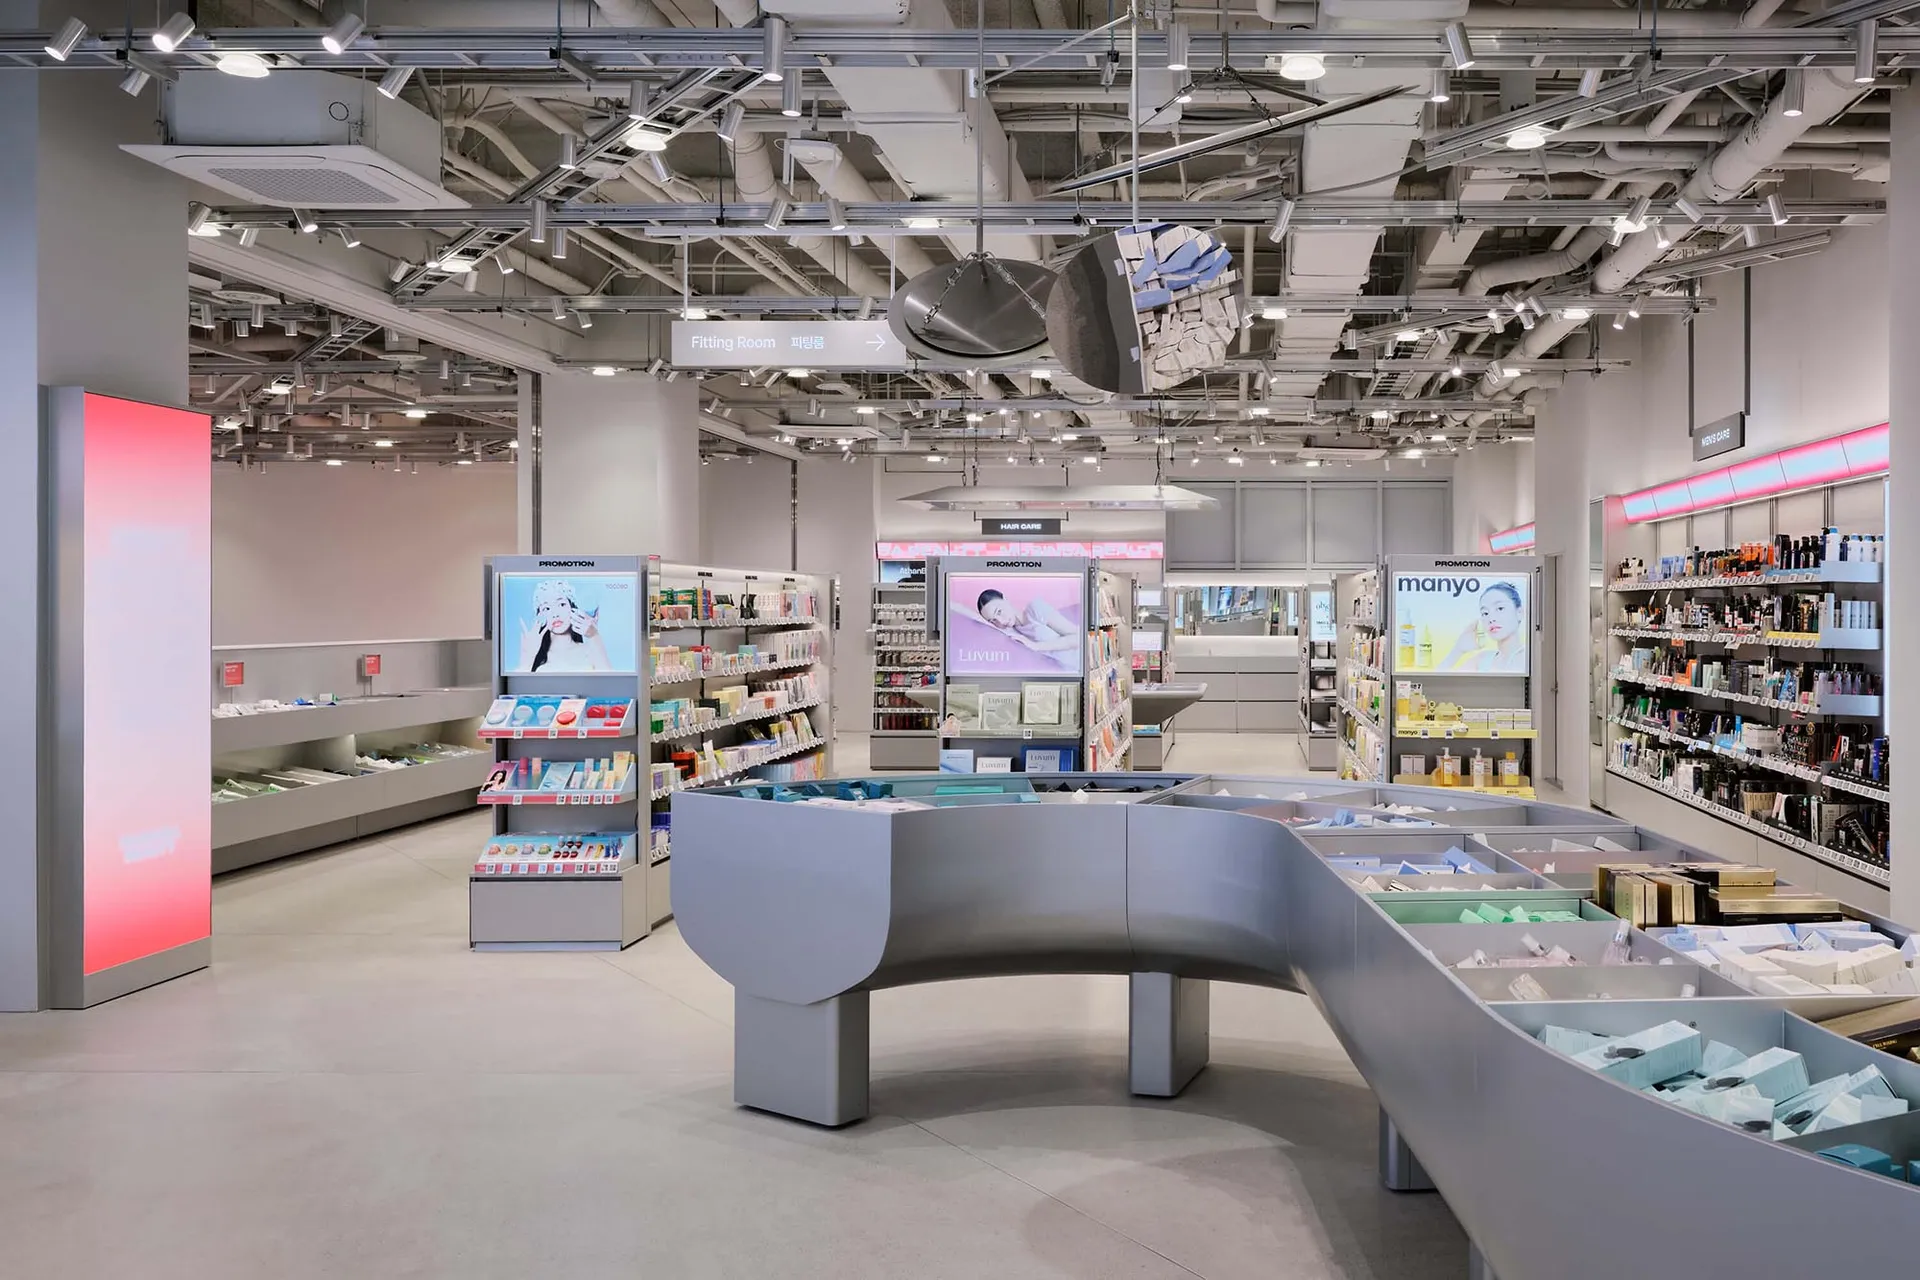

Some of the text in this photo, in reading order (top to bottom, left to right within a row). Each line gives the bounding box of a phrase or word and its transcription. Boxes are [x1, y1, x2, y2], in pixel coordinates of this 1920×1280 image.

[691, 336, 776, 351] Fitting Room
[791, 336, 824, 349] 피팅룸
[1716, 428, 1730, 442] CARE
[1000, 523, 1042, 531] HAIR CARE
[539, 560, 595, 568] PROMOTION
[1434, 560, 1491, 568] PROMOTION
[1398, 577, 1481, 598] manyo
[959, 648, 1010, 662] Luvum
